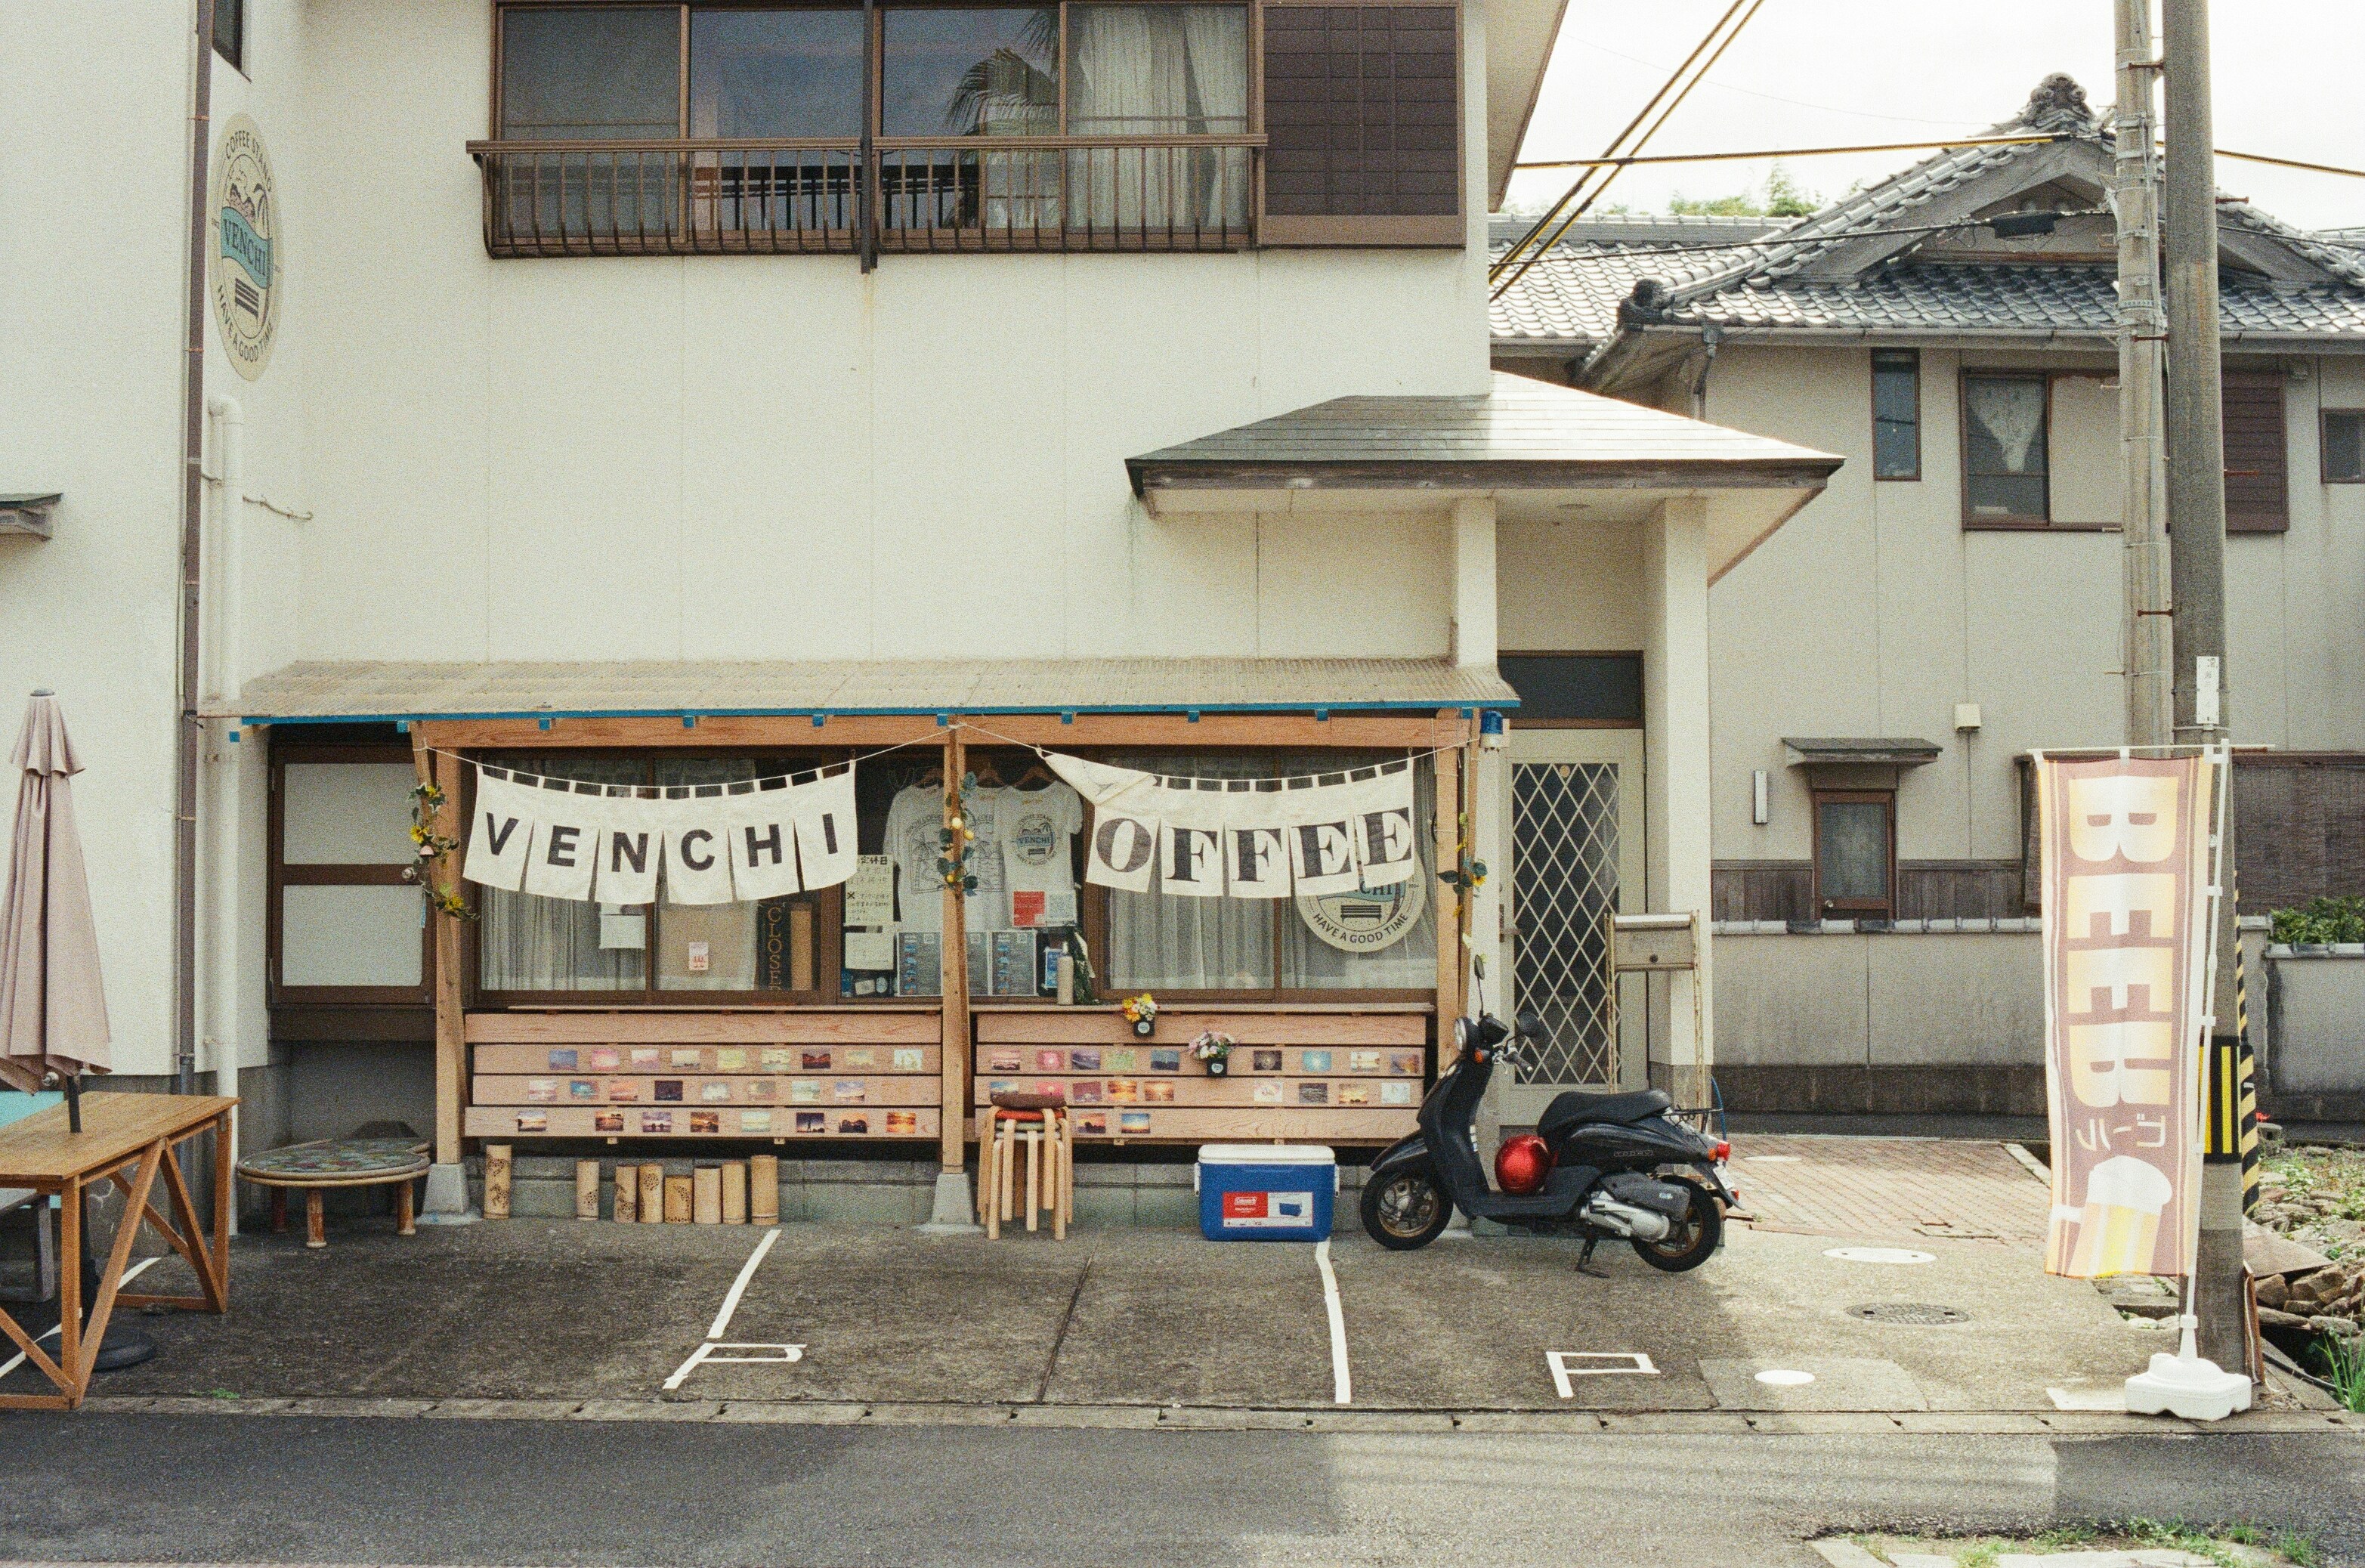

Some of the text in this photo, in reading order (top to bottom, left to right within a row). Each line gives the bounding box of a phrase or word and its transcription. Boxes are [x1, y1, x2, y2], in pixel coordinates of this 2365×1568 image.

[223, 218, 265, 277] VENCHI
[217, 284, 233, 338] HAVE
[233, 332, 239, 350] A
[239, 340, 259, 363] GOOD
[486, 812, 839, 874] VENCHI
[1018, 837, 1050, 845] VENCHI
[1096, 806, 1413, 883] OFFEE
[1313, 913, 1408, 944] HAVE A GOOD TIME
